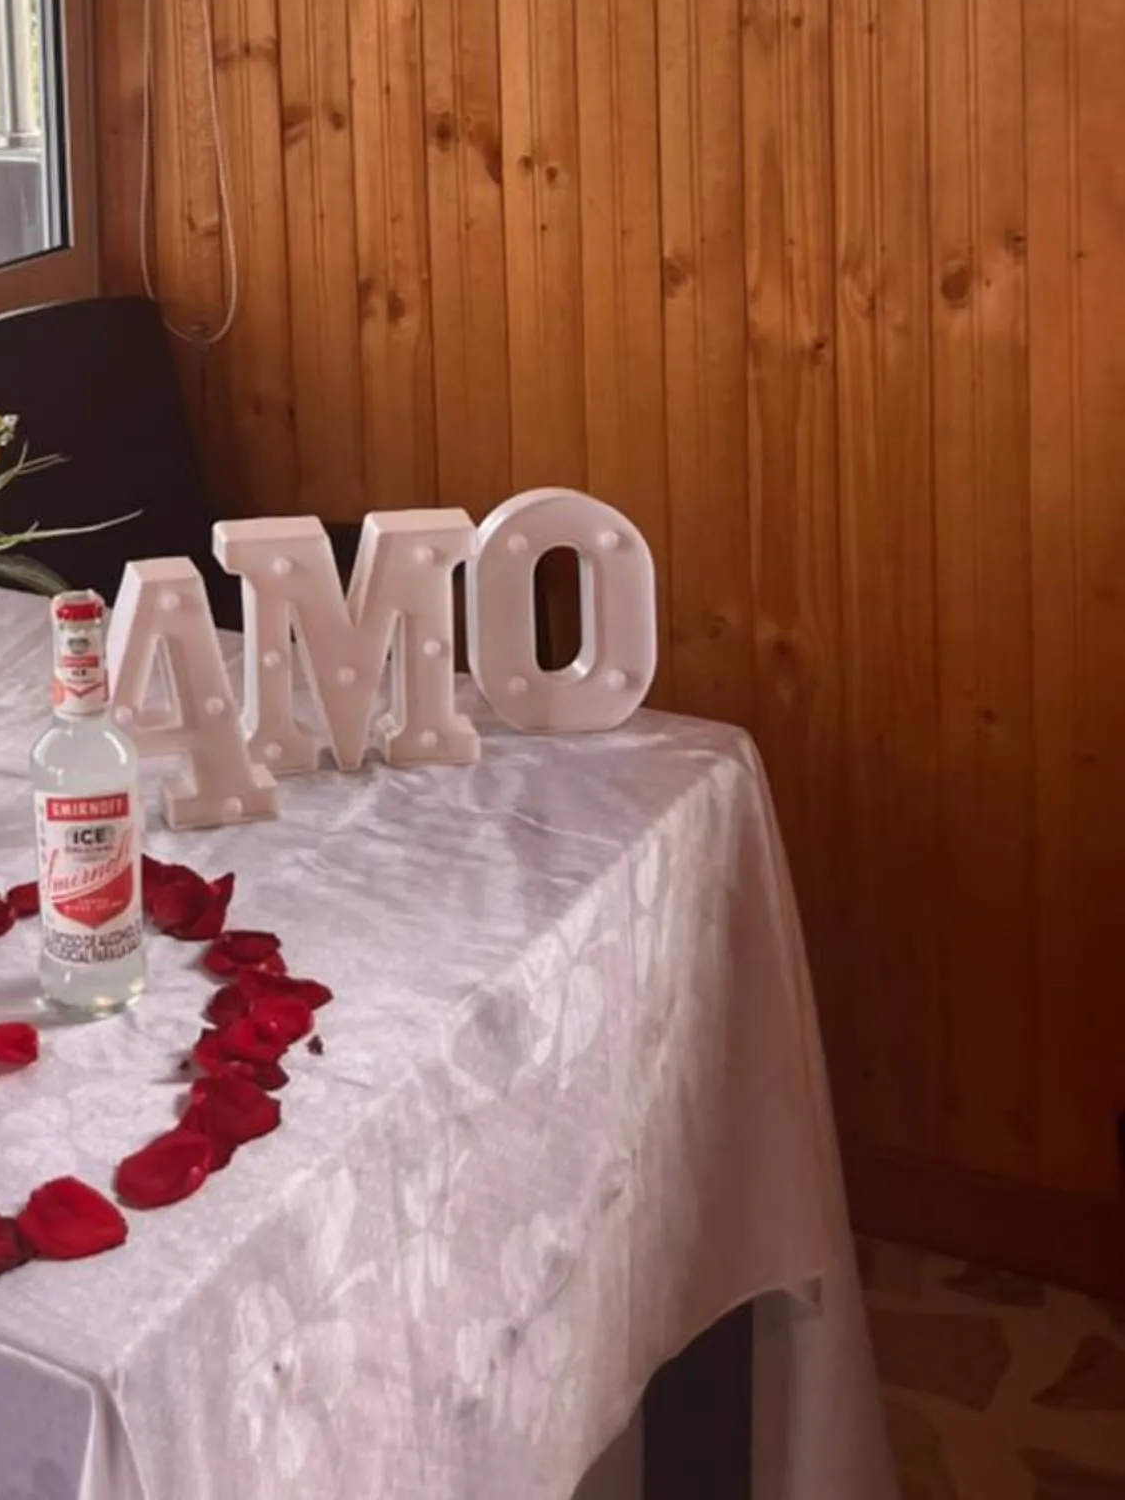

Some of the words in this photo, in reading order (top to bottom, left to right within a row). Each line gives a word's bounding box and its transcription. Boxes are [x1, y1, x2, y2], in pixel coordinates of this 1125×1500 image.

[106, 486, 657, 832] AMO
[52, 797, 123, 818] SMIRNOFF
[72, 829, 107, 845] ICE
